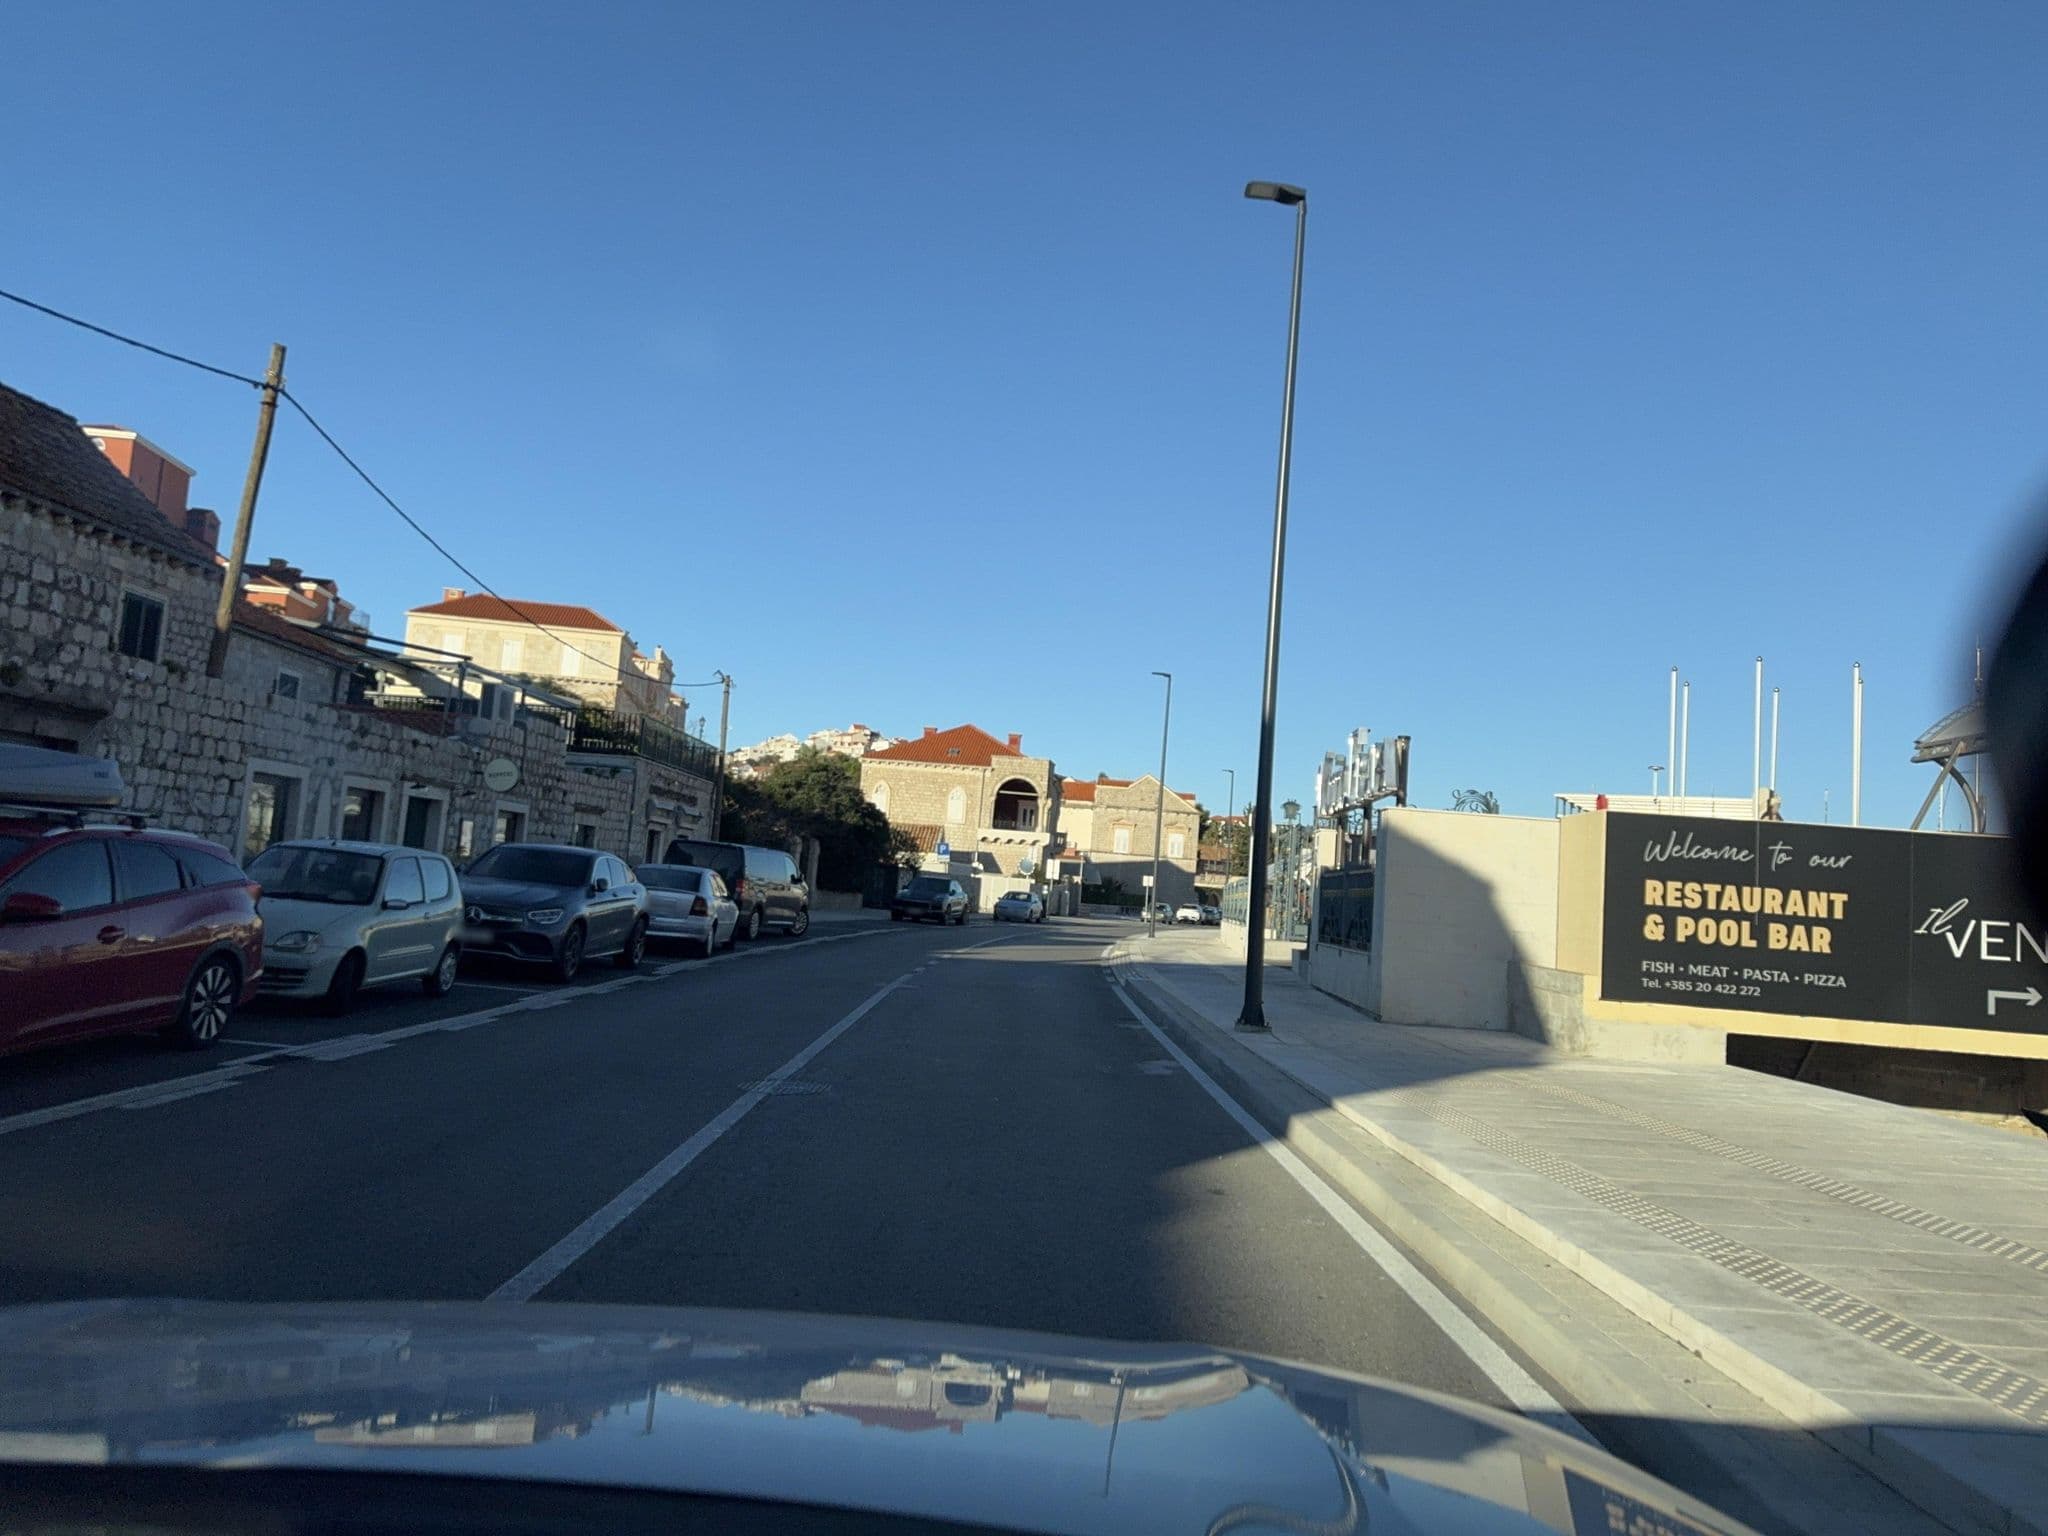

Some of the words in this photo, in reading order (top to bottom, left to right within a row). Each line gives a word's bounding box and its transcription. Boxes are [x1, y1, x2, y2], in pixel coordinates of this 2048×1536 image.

[1643, 831, 1755, 862] Welcome
[1768, 841, 1793, 871] to
[1809, 854, 1852, 869] our
[1644, 879, 1849, 920] RESTAURANT
[1913, 898, 1969, 935] Il
[1643, 914, 1666, 942] &
[1676, 915, 1758, 948] POOL
[1768, 922, 1832, 954] BAR
[1641, 960, 1674, 974] FISH
[1688, 964, 1729, 978] MEAT
[1743, 968, 1790, 983] PASTA
[1804, 973, 1847, 988] PIZZA
[1641, 978, 1661, 989] Tel.
[1664, 980, 1693, 992] +385
[1696, 982, 1712, 993] 20
[1714, 983, 1737, 995] 422
[1739, 985, 1761, 996] 272
